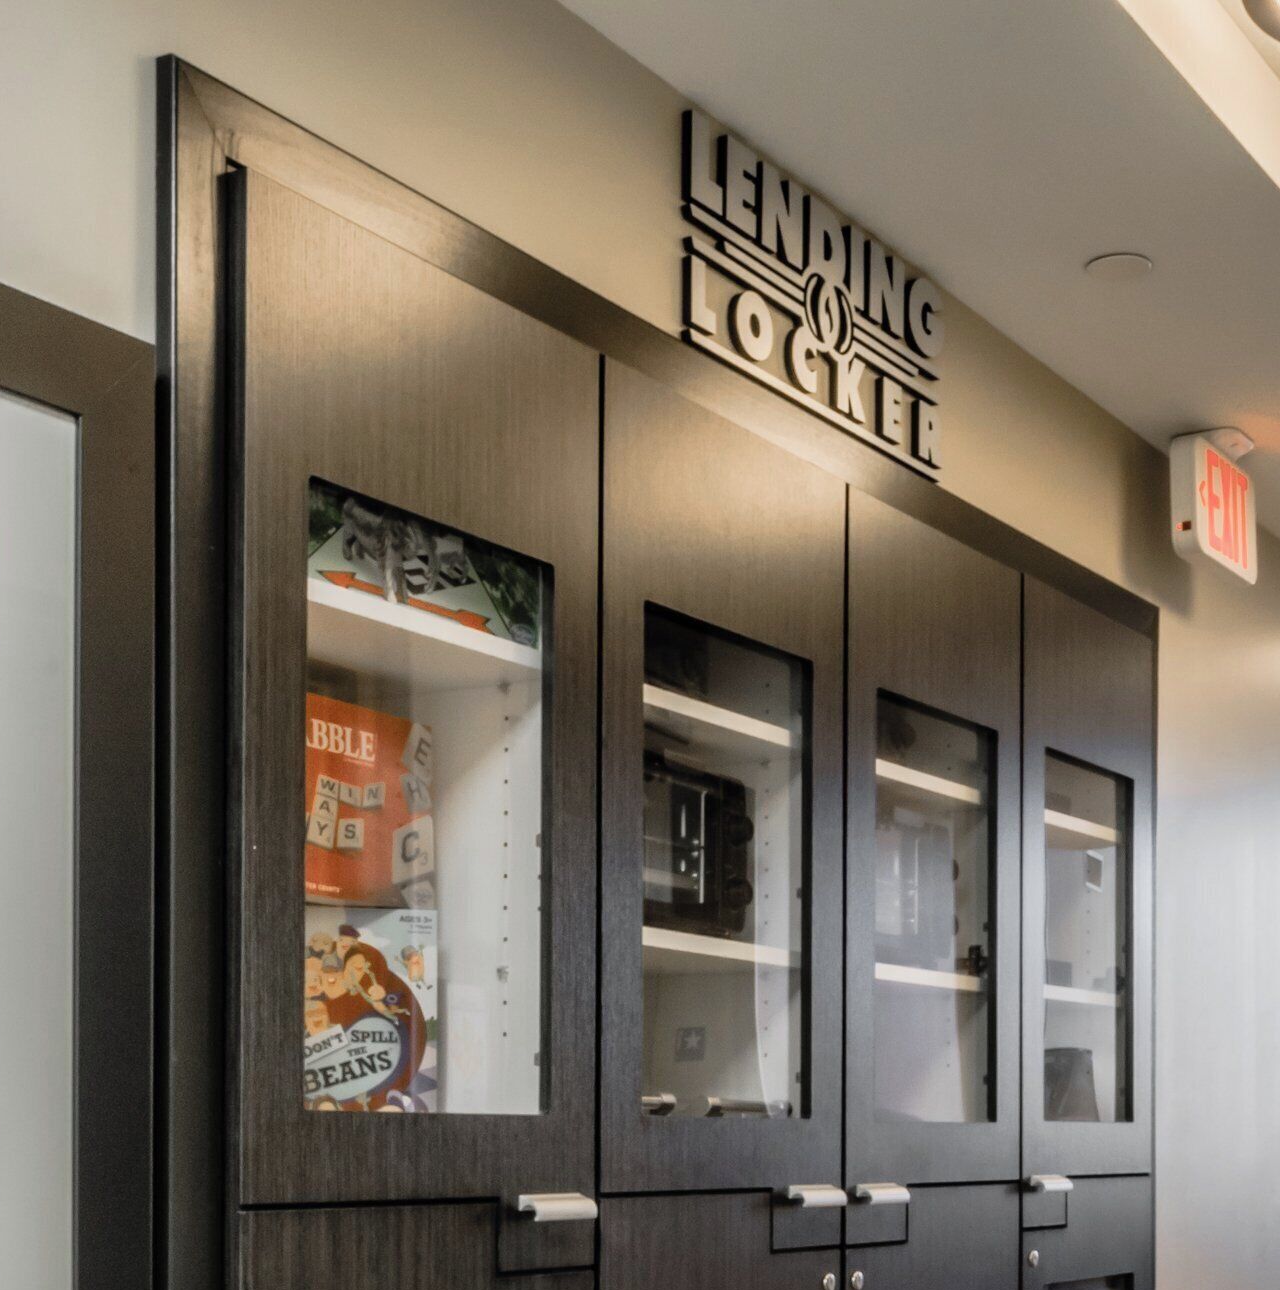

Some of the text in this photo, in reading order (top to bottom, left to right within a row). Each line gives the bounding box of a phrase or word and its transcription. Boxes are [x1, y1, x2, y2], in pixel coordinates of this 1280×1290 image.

[682, 109, 944, 358] LENDING
[682, 255, 942, 469] LOCKER
[1206, 449, 1248, 569] EXIT
[304, 1051, 392, 1094] BEANS
[347, 1046, 367, 1057] THE
[351, 1030, 398, 1043] SPILL
